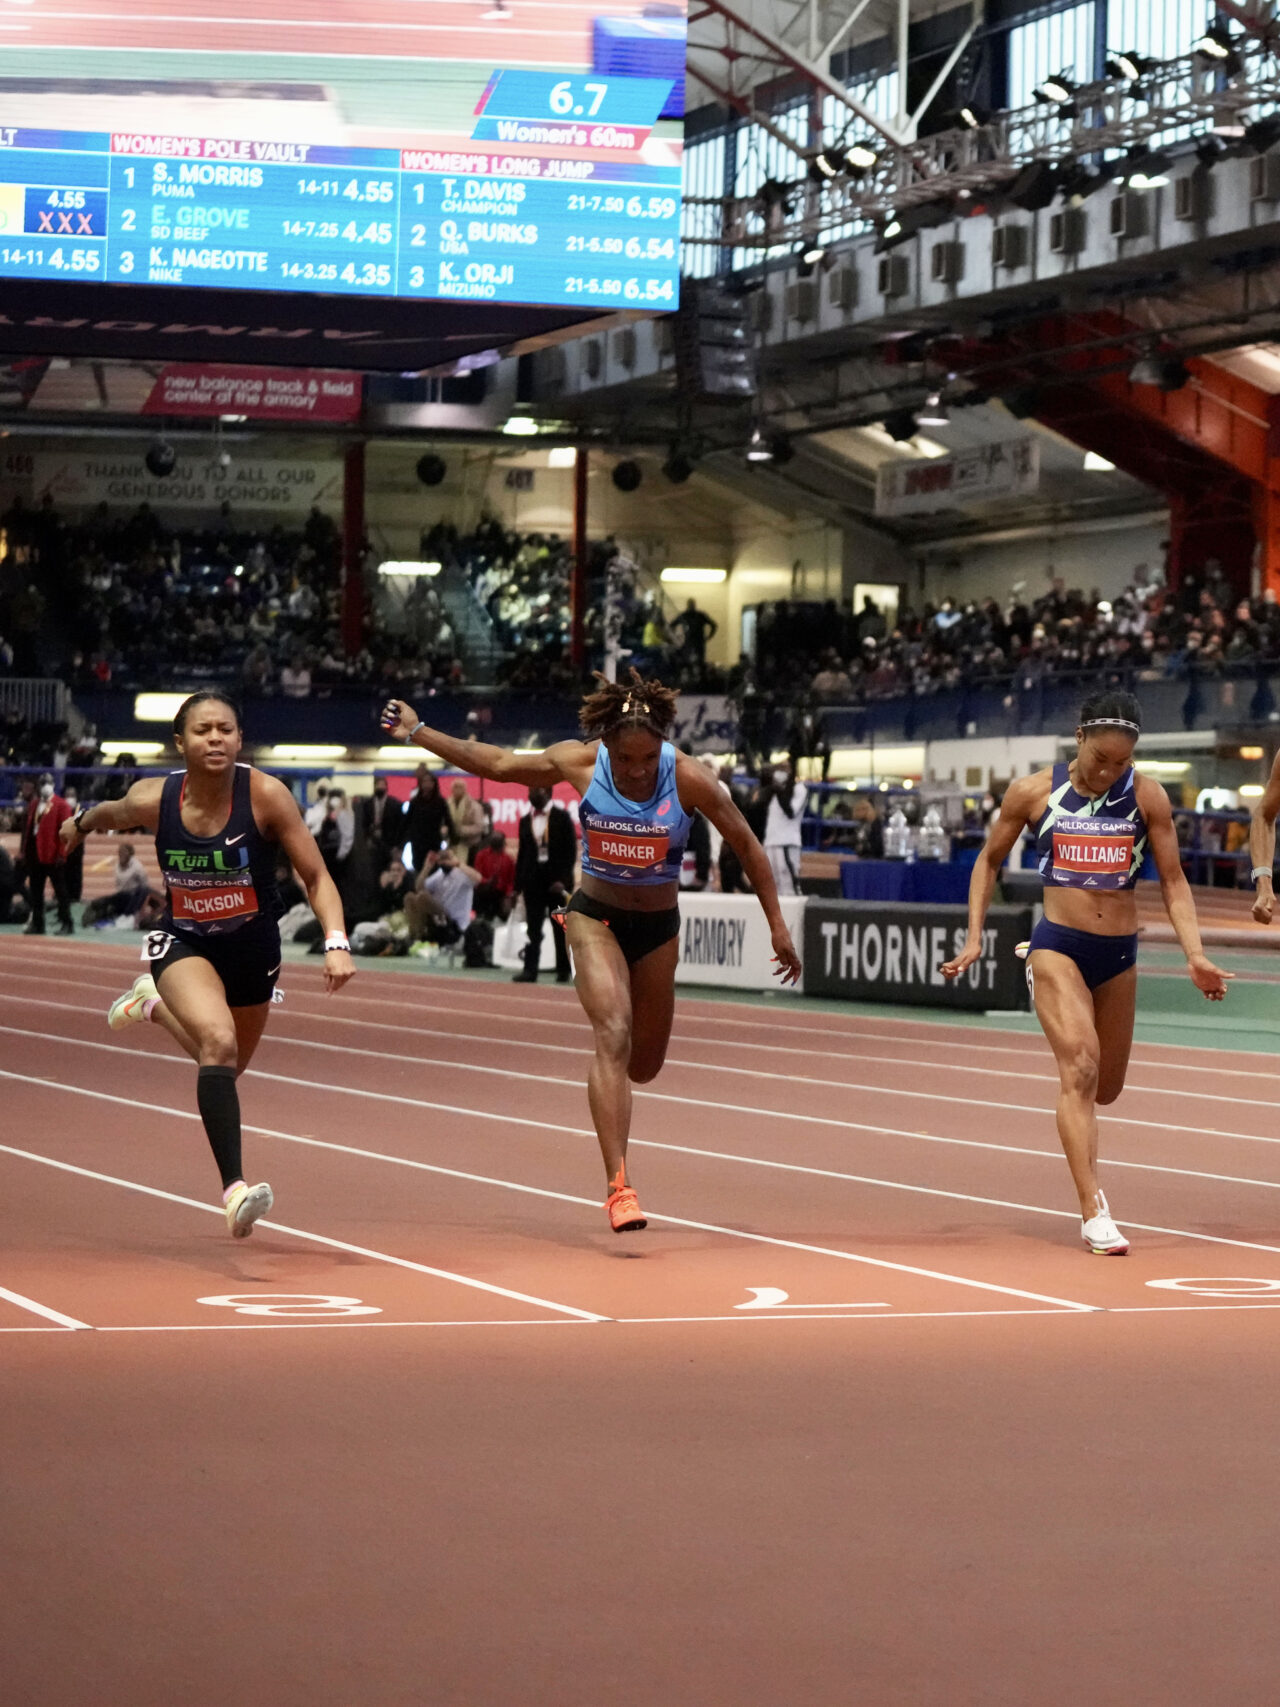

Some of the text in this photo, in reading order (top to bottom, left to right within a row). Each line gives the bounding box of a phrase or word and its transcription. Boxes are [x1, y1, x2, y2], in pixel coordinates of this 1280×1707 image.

[550, 81, 608, 116] 6.7
[497, 121, 634, 148] Women's 60m
[114, 135, 309, 162] WOMEN'S POLE VAULT
[403, 150, 593, 179] WOMEN'S LONG JUMP
[124, 163, 393, 202] 1 S. MORRIS 14-11 4.55
[153, 184, 194, 198] PUMA
[47, 191, 85, 208] 4.55
[413, 179, 676, 219] 1 T. DAVIS 21-7.50 6.59
[441, 200, 517, 215] CHAMPION
[121, 205, 392, 245] 2 E. GROVE 14-7.25 4.45
[151, 226, 209, 241] SD BEEF
[411, 225, 426, 247] 2
[468, 222, 538, 245] BURKS
[566, 236, 622, 254] 21-5.50
[625, 238, 675, 260] 6.54
[440, 241, 469, 255] USA
[4, 248, 99, 271] 14-11 4.55
[119, 247, 391, 285] 3 K. NAGEOTTE 14-3.25 4.35
[149, 268, 183, 282] NIKE
[409, 262, 674, 301] 3 K. ORJI 21-5.50 6.54
[438, 283, 495, 298] MIZUNO
[164, 375, 354, 396] new balance track & field
[164, 389, 213, 403] center
[234, 389, 259, 405] the
[263, 392, 317, 410] armory
[84, 463, 144, 479] THANK
[203, 465, 228, 482] TO
[236, 467, 268, 483] ALL
[277, 467, 316, 484] OUR
[107, 482, 292, 502] GENEROUS DONORS
[589, 820, 667, 834] MILLROSE GAMES
[1057, 820, 1133, 832] MILLROSE GAMES
[601, 840, 655, 859] PARKER
[1058, 843, 1127, 863] WILLIAMS
[168, 876, 249, 887] MILLROSE GAMES
[183, 892, 245, 913] JACKSON
[148, 932, 170, 958] 8
[684, 917, 746, 967] ARMORY
[953, 927, 998, 958] ST
[821, 922, 947, 987] THORNE
[195, 1294, 384, 1317] 8
